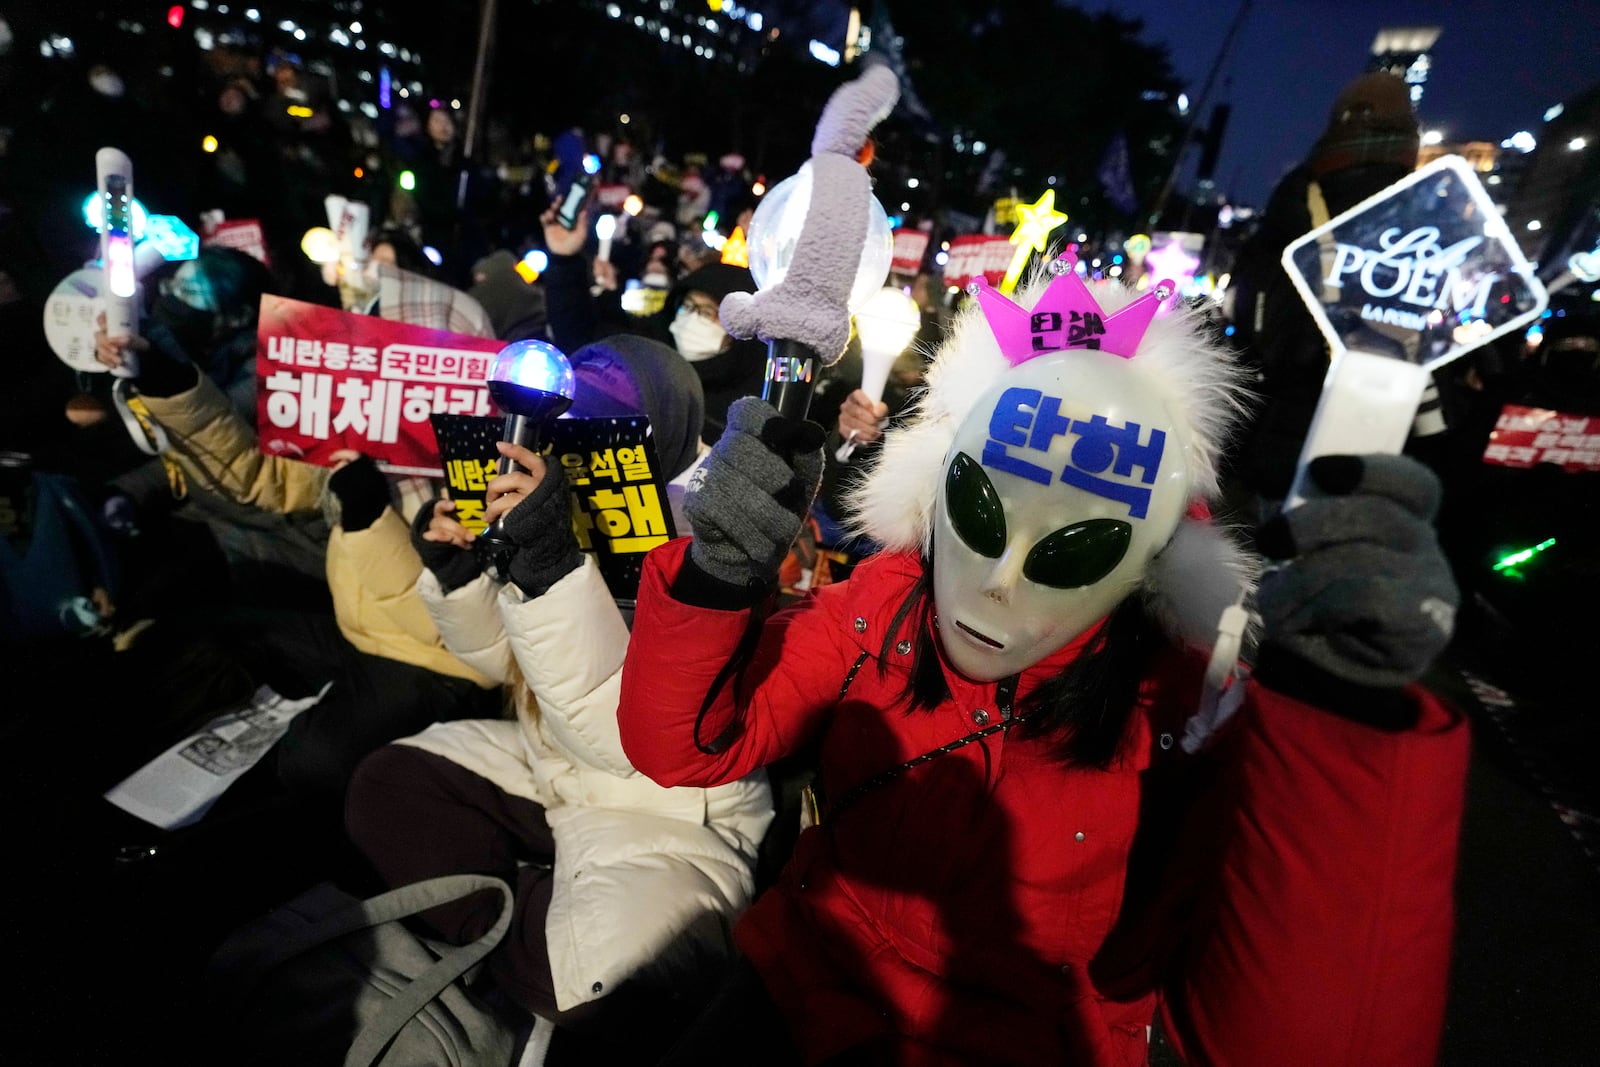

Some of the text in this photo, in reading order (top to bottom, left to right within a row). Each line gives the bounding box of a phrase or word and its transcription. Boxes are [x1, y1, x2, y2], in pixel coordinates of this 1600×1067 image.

[1323, 242, 1501, 318] POEM
[267, 336, 488, 380] 내란동조 국민의힘
[1030, 310, 1106, 351] 탄핵
[981, 386, 1166, 520] 탄핵
